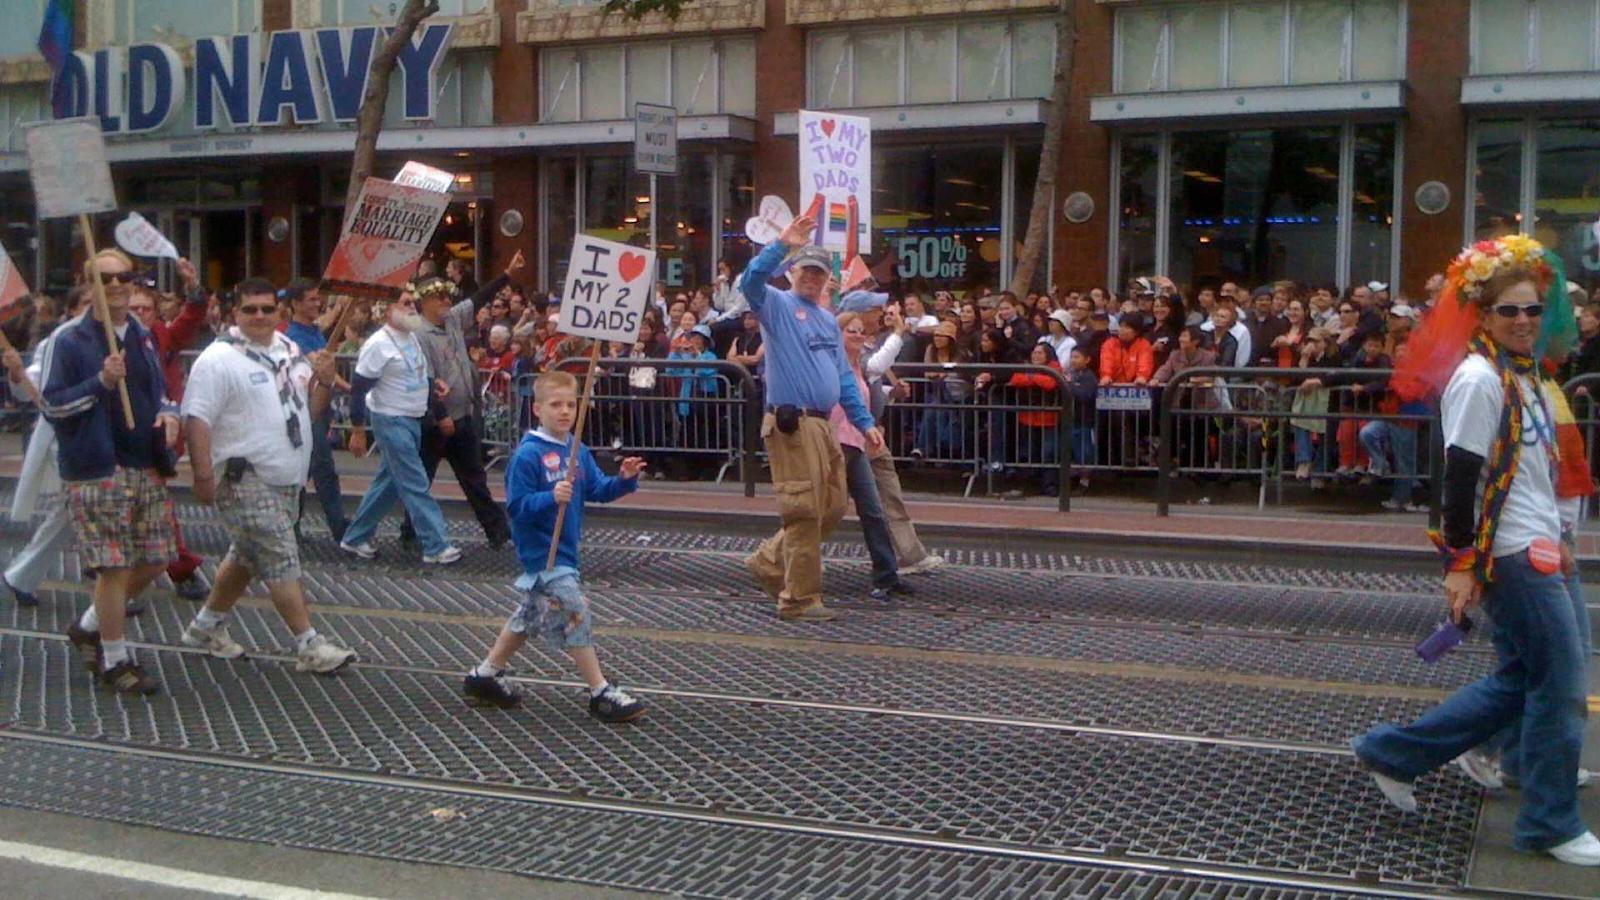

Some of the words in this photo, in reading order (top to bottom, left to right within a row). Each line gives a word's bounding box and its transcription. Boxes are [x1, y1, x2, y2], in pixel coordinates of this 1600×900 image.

[194, 24, 452, 129] NAVY
[805, 121, 821, 143] I
[838, 121, 868, 151] MY
[812, 144, 858, 168] TWO
[813, 169, 859, 194] DADS
[355, 203, 436, 229] MARRIAGE
[350, 218, 432, 244] EQUALITY
[582, 245, 610, 278] I
[897, 236, 967, 278] 50%
[940, 262, 967, 278] OFF
[571, 279, 609, 304] MY
[615, 287, 631, 308] 2
[571, 305, 638, 333] DADS
